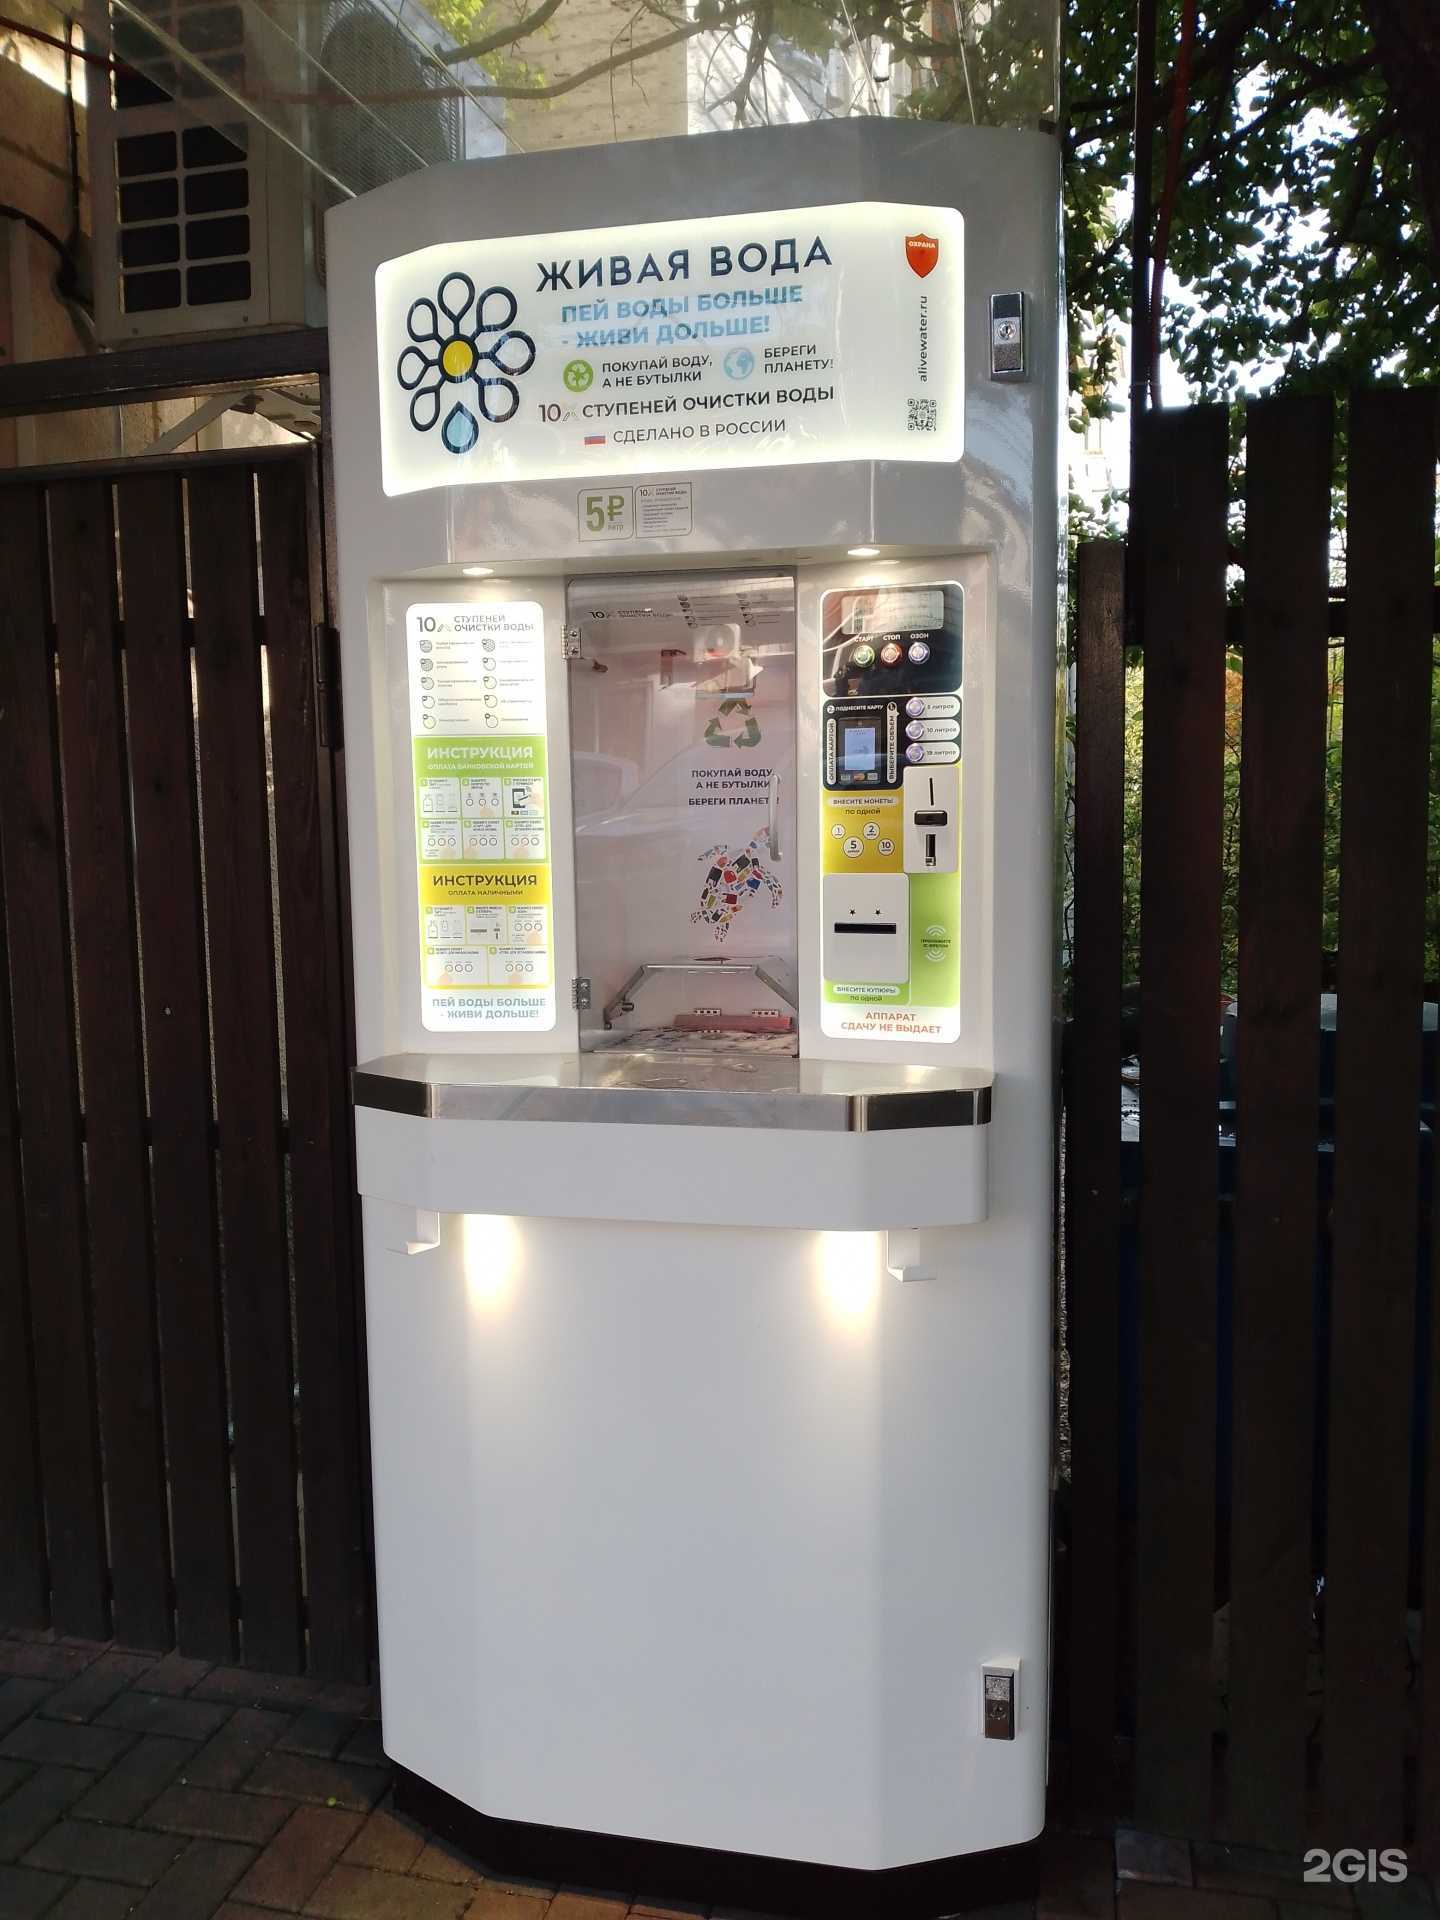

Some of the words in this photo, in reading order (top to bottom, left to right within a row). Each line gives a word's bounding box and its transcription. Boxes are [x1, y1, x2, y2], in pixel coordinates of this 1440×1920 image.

[908, 240, 936, 249] ОХРАНА
[536, 249, 690, 292] ЖИВАЯ
[710, 236, 832, 277] ВОДА
[561, 299, 609, 323] ПЕЙ
[616, 295, 689, 320] ВОДЫ
[697, 285, 803, 311] БОЛЬШЕ
[576, 327, 649, 348] ЖИВИ
[656, 315, 770, 345] ДОЛЬШЕ!
[917, 296, 928, 382] alivewater.ru
[764, 344, 817, 359] БЕРЕГИ
[602, 356, 668, 374] ПОКУПАЙ
[672, 354, 713, 369] ВОДУ,
[764, 359, 834, 375] ПЛАНЕТУ!
[602, 378, 612, 388] А
[615, 376, 634, 387] НЕ
[637, 371, 702, 386] БУТЫЛКИ
[538, 403, 562, 423] 10
[582, 396, 677, 418] СТУПЕНЕЙ
[683, 390, 770, 411] ОЧИСТКИ
[776, 386, 834, 404] ВОДЫ
[613, 425, 695, 444] СДЕЛАНО
[700, 424, 710, 437] В
[716, 419, 786, 436] РОССИИ
[416, 616, 436, 632] 10
[454, 614, 506, 623] СТУПЕНЕЙ
[454, 623, 501, 632] ОЧИСТКИ
[503, 623, 534, 632] ВОДЫ
[427, 746, 533, 760] ИНСТРУКЦИЯ
[692, 767, 743, 778] ПОКУПАЙ
[696, 781, 703, 789] А
[705, 781, 720, 789] НЕ
[722, 780, 770, 789] БУТЫЛКИ
[689, 798, 726, 806] БЕРЕГИ
[729, 797, 780, 805] ПЛАНЕТ!
[869, 825, 875, 833] 2
[850, 840, 857, 849] 5
[881, 841, 891, 849] 10
[433, 875, 538, 887] ИНСТРУКЦИЯ
[432, 997, 455, 1007] ПЕЙ
[458, 998, 494, 1008] ВОДЫ
[497, 998, 546, 1007] БОЛЬШЕ
[448, 1010, 482, 1018] ЖИВИ
[485, 1010, 540, 1019] ДОЛЬШЕ!
[866, 1012, 916, 1022] АППАРАТ
[841, 1022, 876, 1032] СДАЧУ
[880, 1023, 893, 1031] НЕ
[896, 1024, 942, 1034] ВЫДАЕТ
